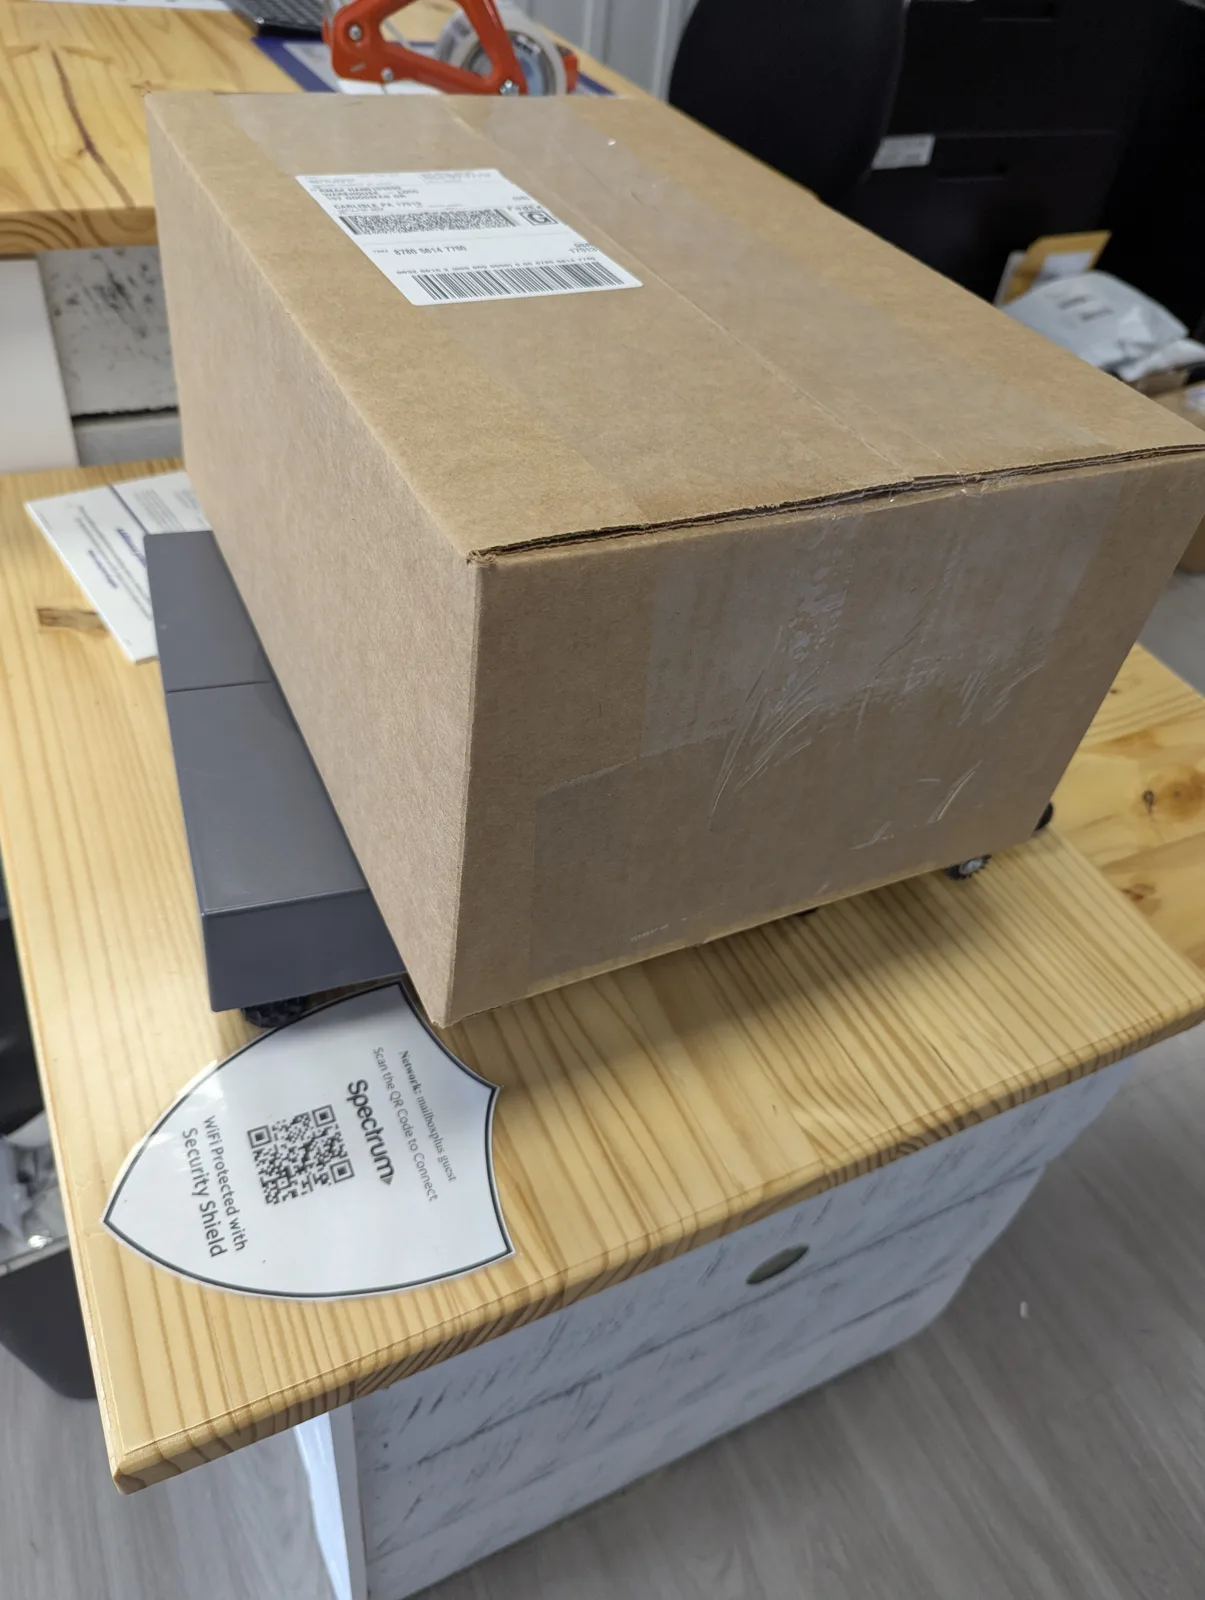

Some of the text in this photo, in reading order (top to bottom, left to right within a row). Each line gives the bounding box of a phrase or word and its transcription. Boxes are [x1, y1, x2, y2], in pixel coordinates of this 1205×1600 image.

[346, 1078, 395, 1180] Spectrum
[373, 1046, 438, 1202] Scan the QR Code to Connect
[399, 1050, 457, 1182] Network: mailboxplus guest
[182, 1127, 228, 1258] Security Shield
[203, 1114, 249, 1252] WiFi Protected with
